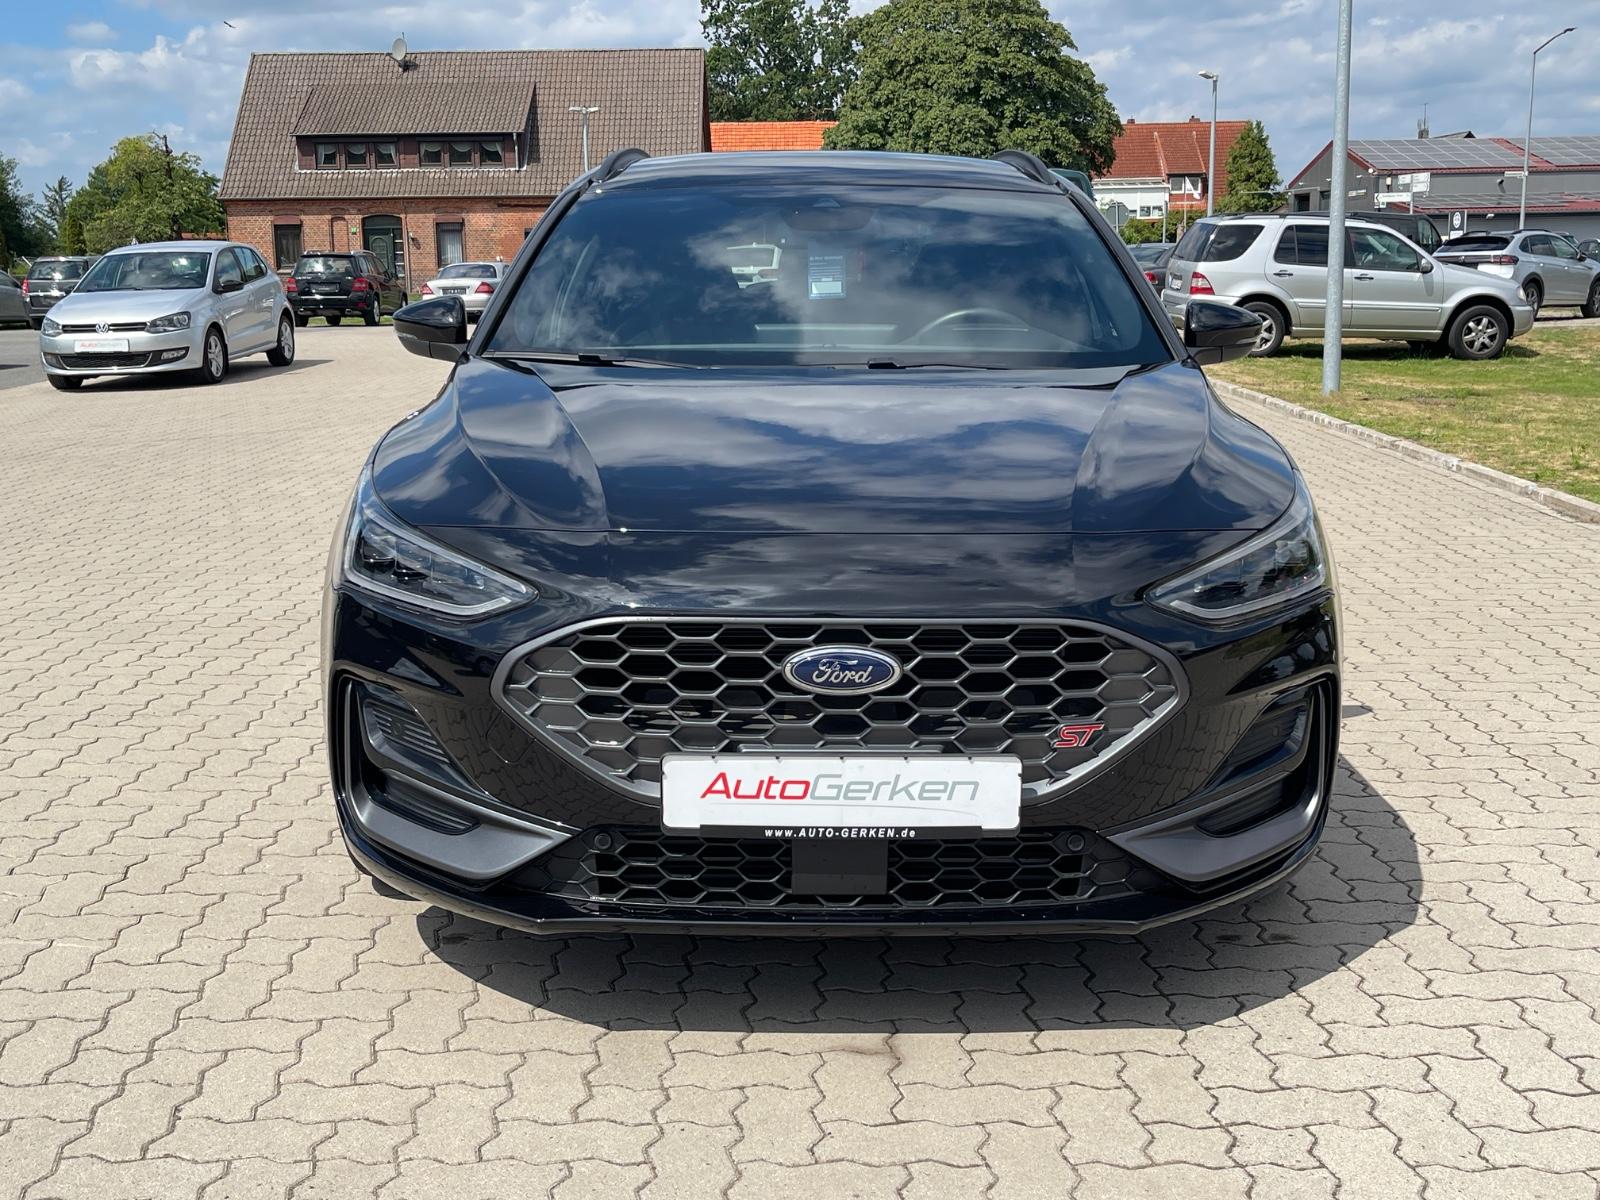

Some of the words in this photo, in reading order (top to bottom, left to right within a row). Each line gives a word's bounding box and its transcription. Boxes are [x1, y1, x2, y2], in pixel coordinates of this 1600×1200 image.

[812, 659, 872, 684] Ford
[1055, 723, 1104, 747] ST
[701, 772, 979, 801] AutoGerken
[764, 827, 917, 839] www.AUTO-GERKEN.de
